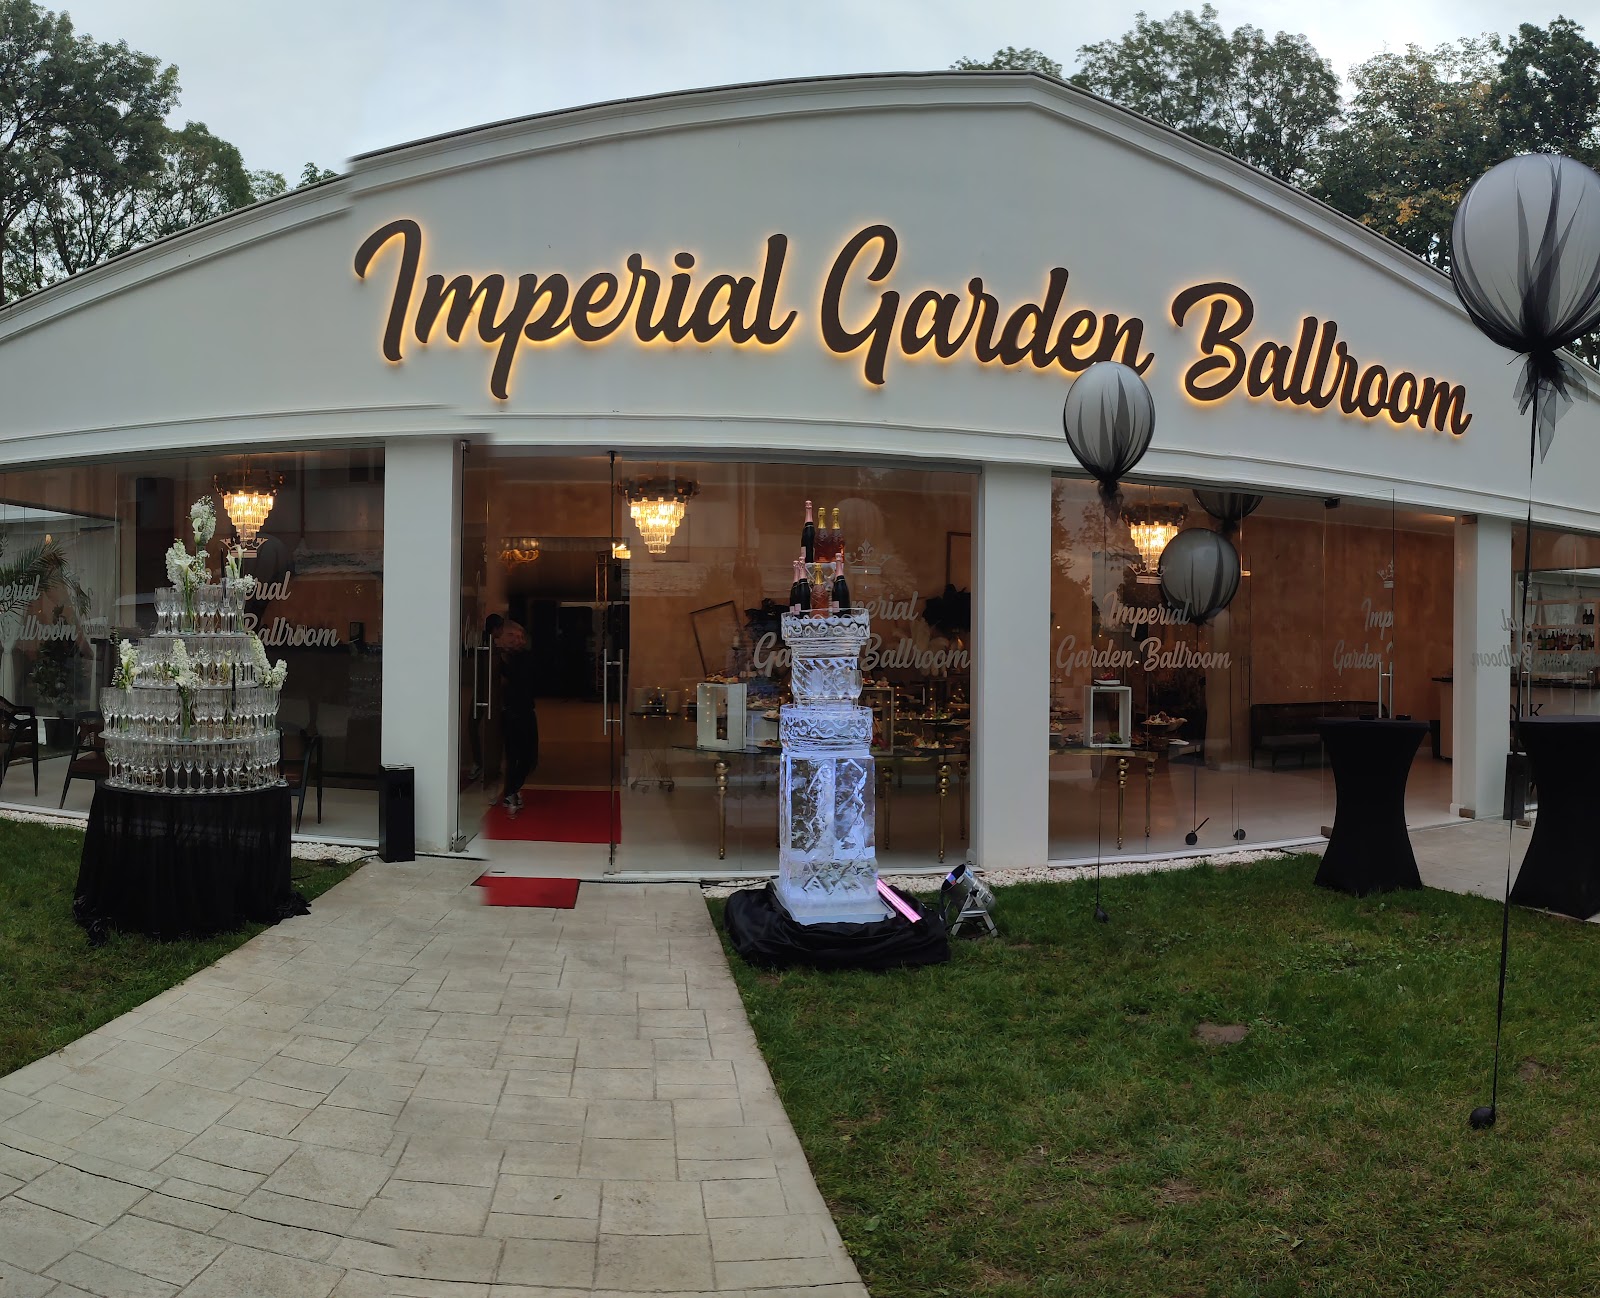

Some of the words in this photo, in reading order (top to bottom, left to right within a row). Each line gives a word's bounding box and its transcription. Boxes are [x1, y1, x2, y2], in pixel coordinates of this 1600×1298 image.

[354, 218, 798, 400] Imperial
[820, 224, 1154, 385] Garden
[1171, 282, 1473, 435] Ballroom
[1103, 591, 1190, 638] Imperial
[860, 633, 971, 672] Ballroom
[1056, 635, 1135, 677] Garden
[1139, 636, 1232, 672] Ballroom
